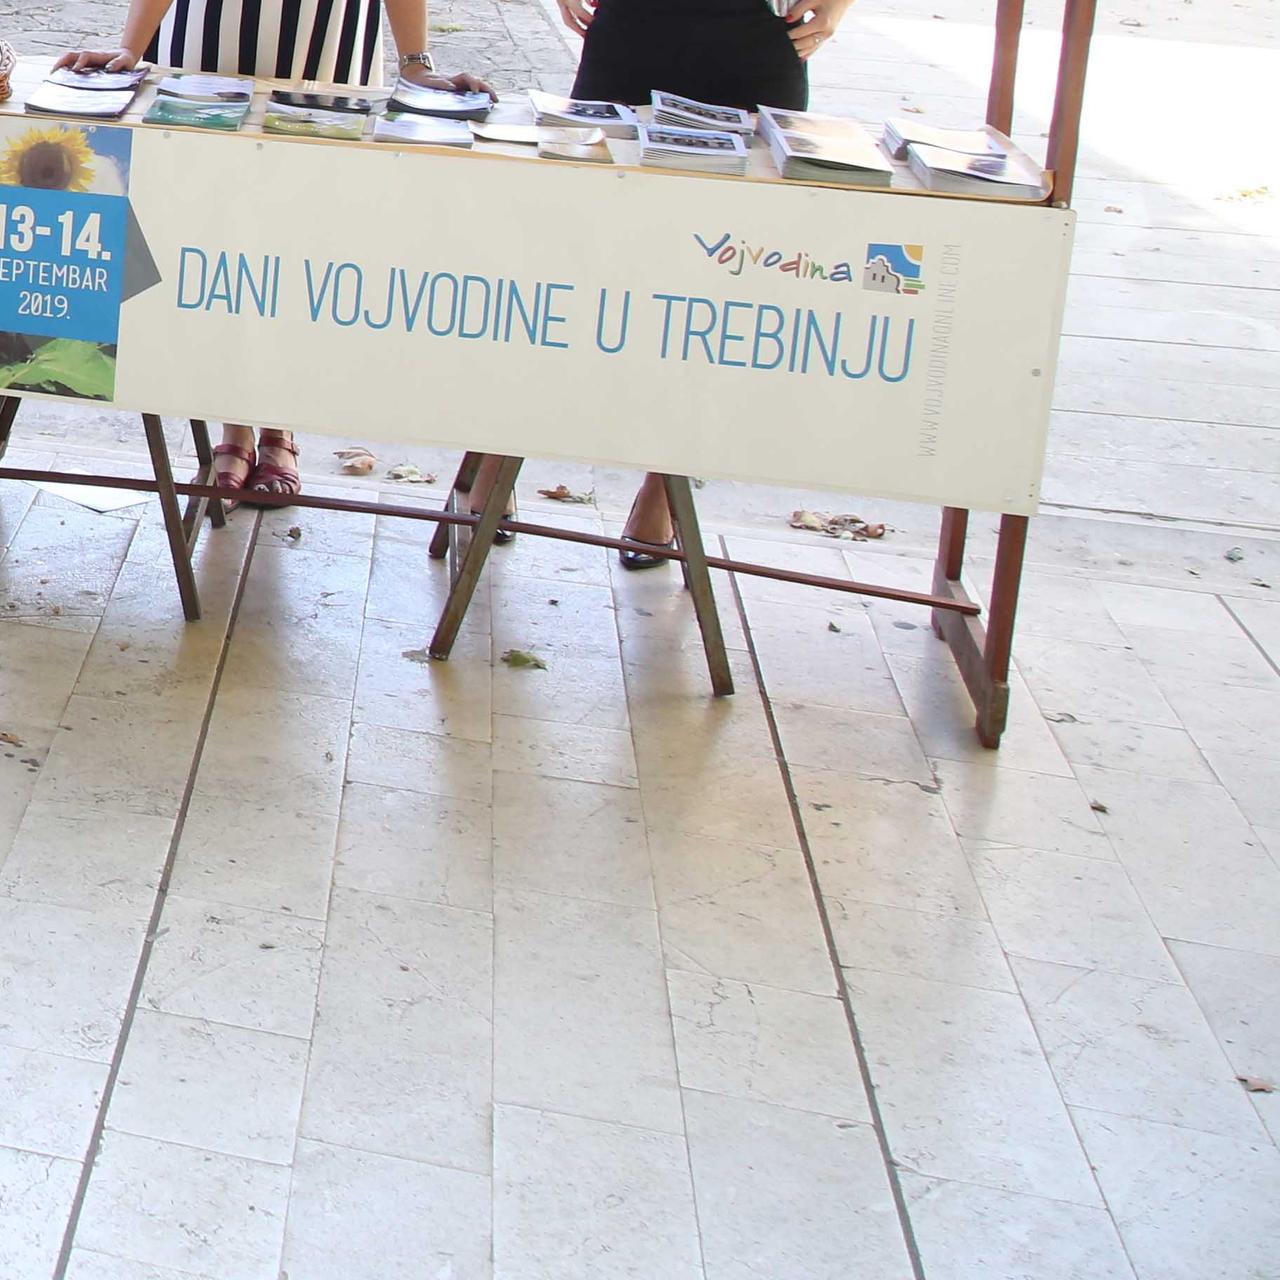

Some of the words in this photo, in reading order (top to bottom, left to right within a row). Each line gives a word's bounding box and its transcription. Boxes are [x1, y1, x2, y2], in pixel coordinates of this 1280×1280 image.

[693, 233, 853, 282] Vojvodina
[18, 291, 70, 319] 2019.
[177, 247, 280, 318] DANI
[304, 259, 575, 349] VOJVODINE
[595, 288, 632, 353] U
[652, 293, 915, 383] TREBINJU
